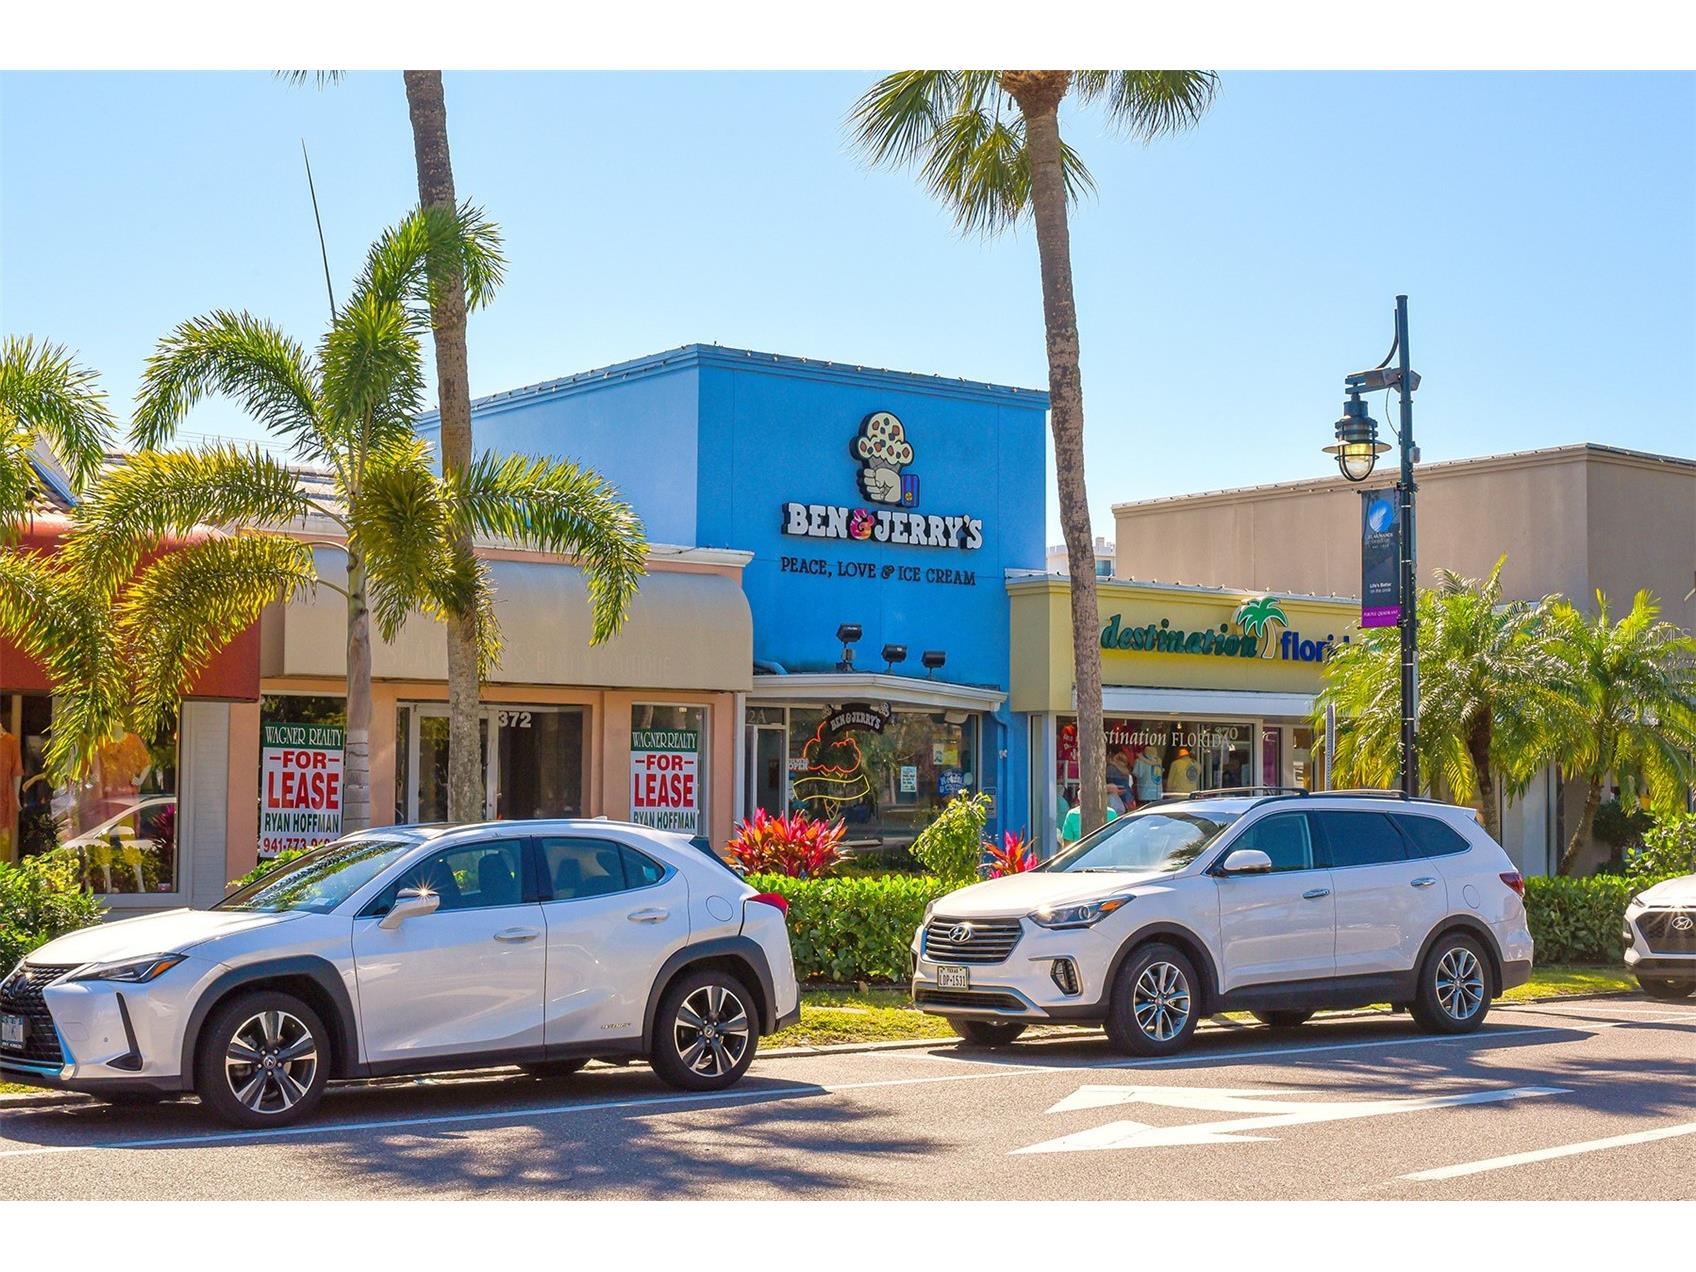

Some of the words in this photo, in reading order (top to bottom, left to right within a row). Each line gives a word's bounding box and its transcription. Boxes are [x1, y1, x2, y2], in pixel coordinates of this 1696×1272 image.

[781, 556, 833, 577] PEACE,
[837, 561, 877, 579] LOVE
[899, 567, 922, 583] ICE
[926, 568, 976, 586] CREAM
[1101, 614, 1258, 658] destination
[1281, 630, 1349, 662] flori
[498, 711, 532, 728] 372
[265, 726, 306, 746] WAGNER
[309, 727, 343, 747] REALTY
[632, 731, 668, 748] WAGNER
[668, 732, 697, 749] REALTY
[1104, 727, 1167, 747] stination
[1172, 732, 1230, 749] FLORIDA
[282, 751, 327, 769] FOR
[646, 754, 684, 771] FOR
[267, 771, 339, 809] LEASE
[634, 773, 694, 808] LEASE
[264, 812, 290, 832] RYAN
[293, 813, 339, 833] HOFFMAN
[633, 811, 655, 828] RYAN
[657, 812, 696, 829] HOFFMAN
